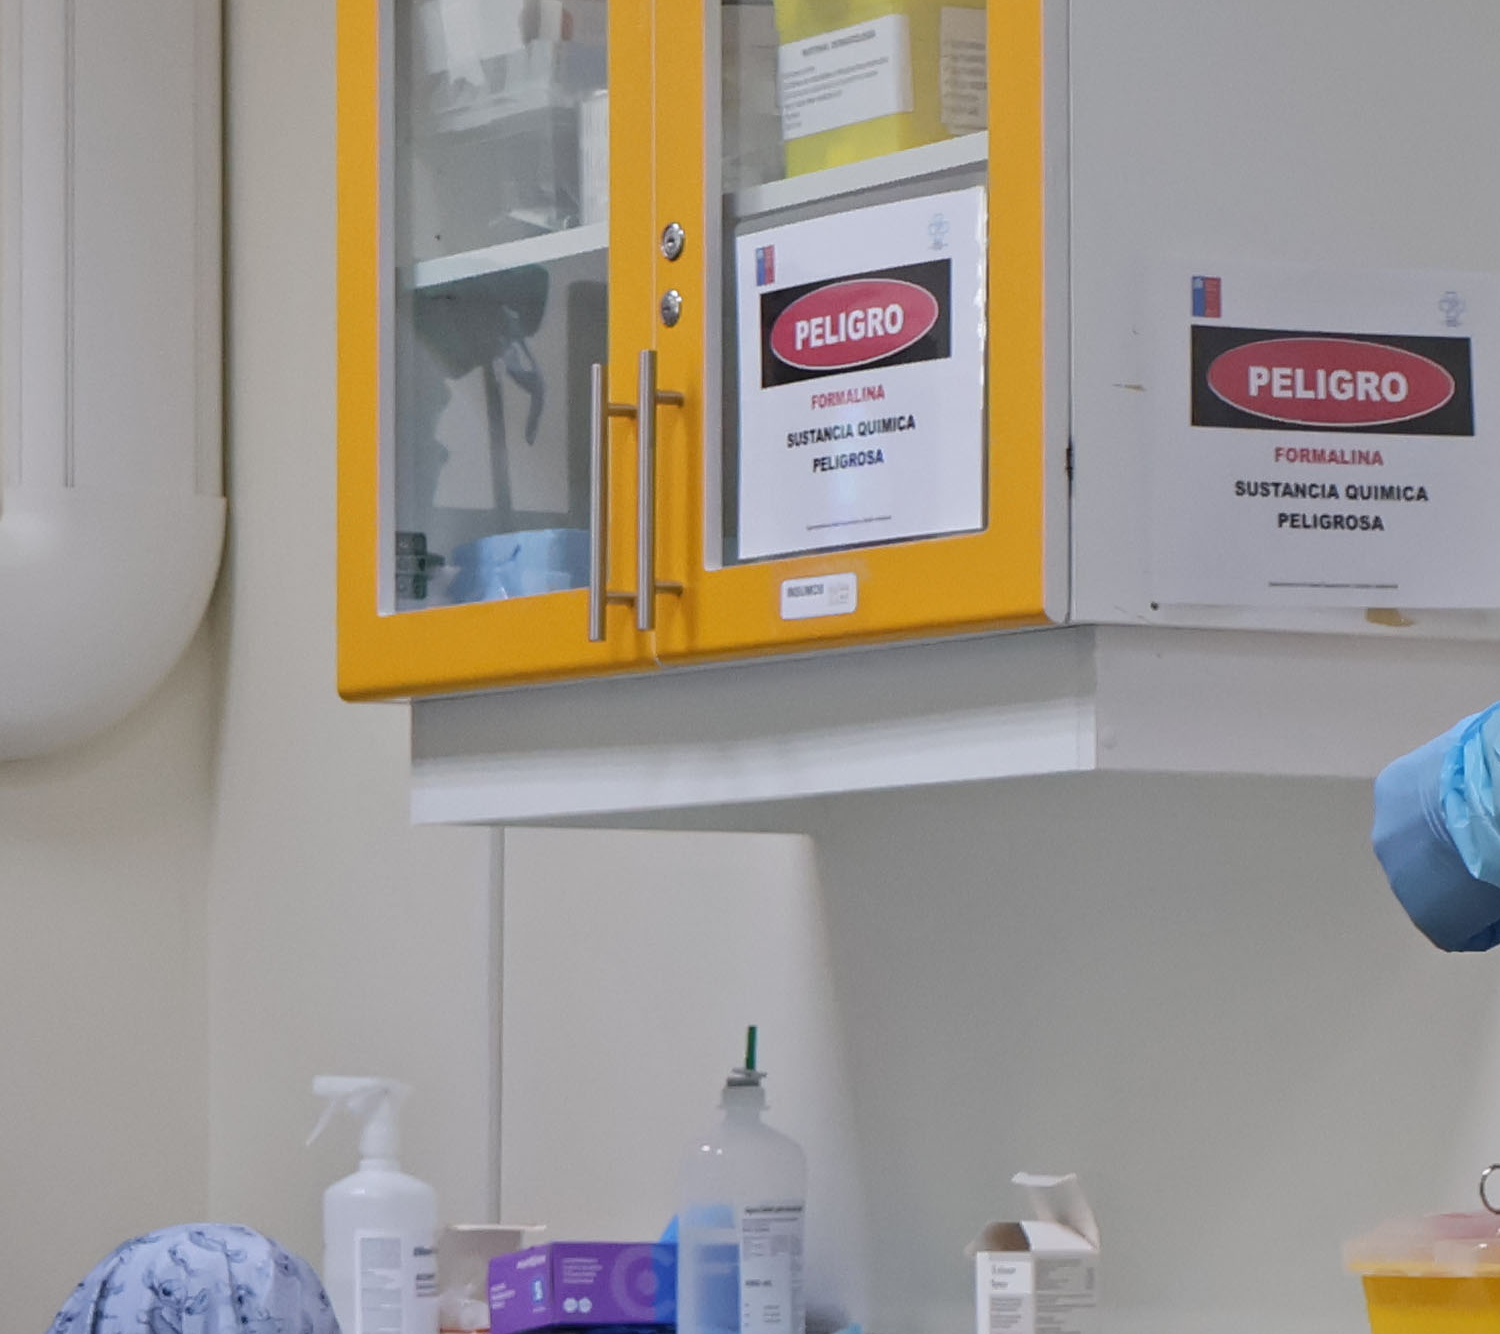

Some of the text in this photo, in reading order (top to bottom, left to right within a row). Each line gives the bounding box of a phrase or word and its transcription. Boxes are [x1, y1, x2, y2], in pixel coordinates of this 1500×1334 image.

[794, 303, 905, 351] PELIGRO
[811, 384, 886, 410] FORMALINA
[1248, 365, 1408, 403] PELIGRO
[787, 414, 916, 449] SUSTANCIA QUIMICA
[812, 448, 884, 474] PELIGROSA
[1274, 446, 1384, 467] FORMALINA
[1235, 480, 1429, 502] SUSTANCIA QUIMICA
[1277, 512, 1385, 532] PELIGROSA
